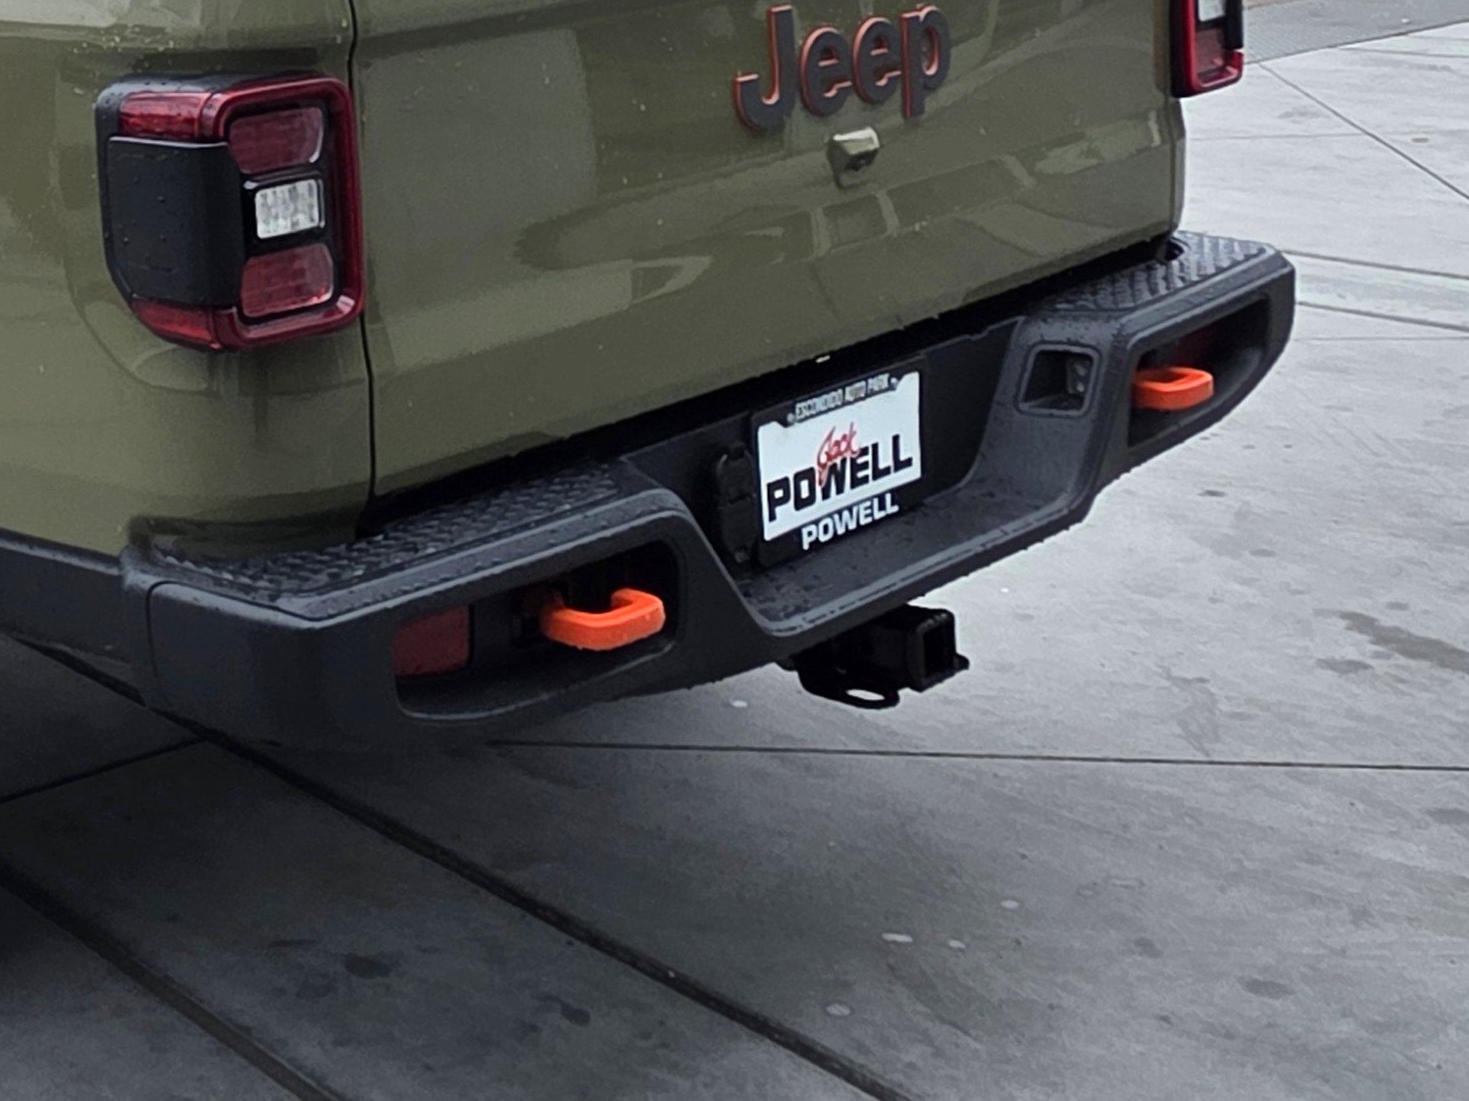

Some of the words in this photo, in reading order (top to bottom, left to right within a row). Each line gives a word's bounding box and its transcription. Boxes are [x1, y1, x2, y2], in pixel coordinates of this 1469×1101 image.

[732, 3, 952, 136] Jeep
[766, 434, 913, 523] POWELL
[801, 492, 900, 551] POWELL
